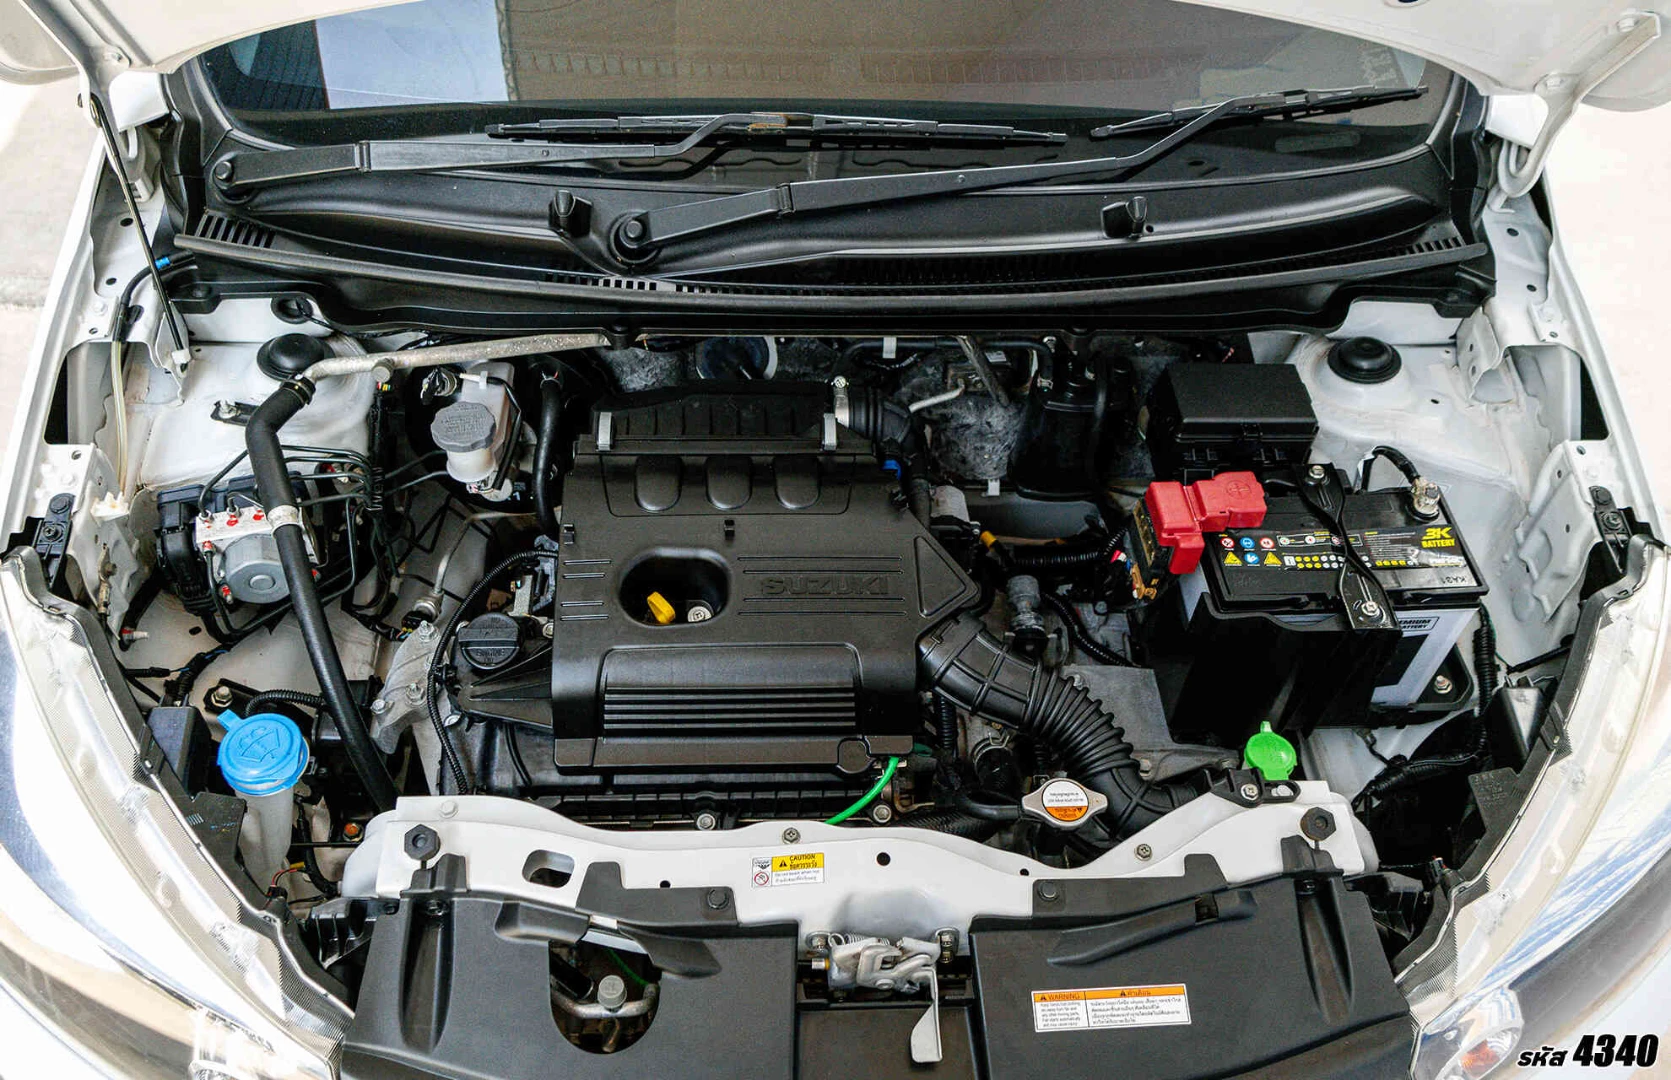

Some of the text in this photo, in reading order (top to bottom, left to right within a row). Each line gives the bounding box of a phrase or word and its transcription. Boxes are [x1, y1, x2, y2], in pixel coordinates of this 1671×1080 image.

[1422, 527, 1452, 539] 3K
[1421, 539, 1455, 548] BATTERY
[761, 576, 889, 594] SUZUKI
[1048, 992, 1080, 1000] WARNING
